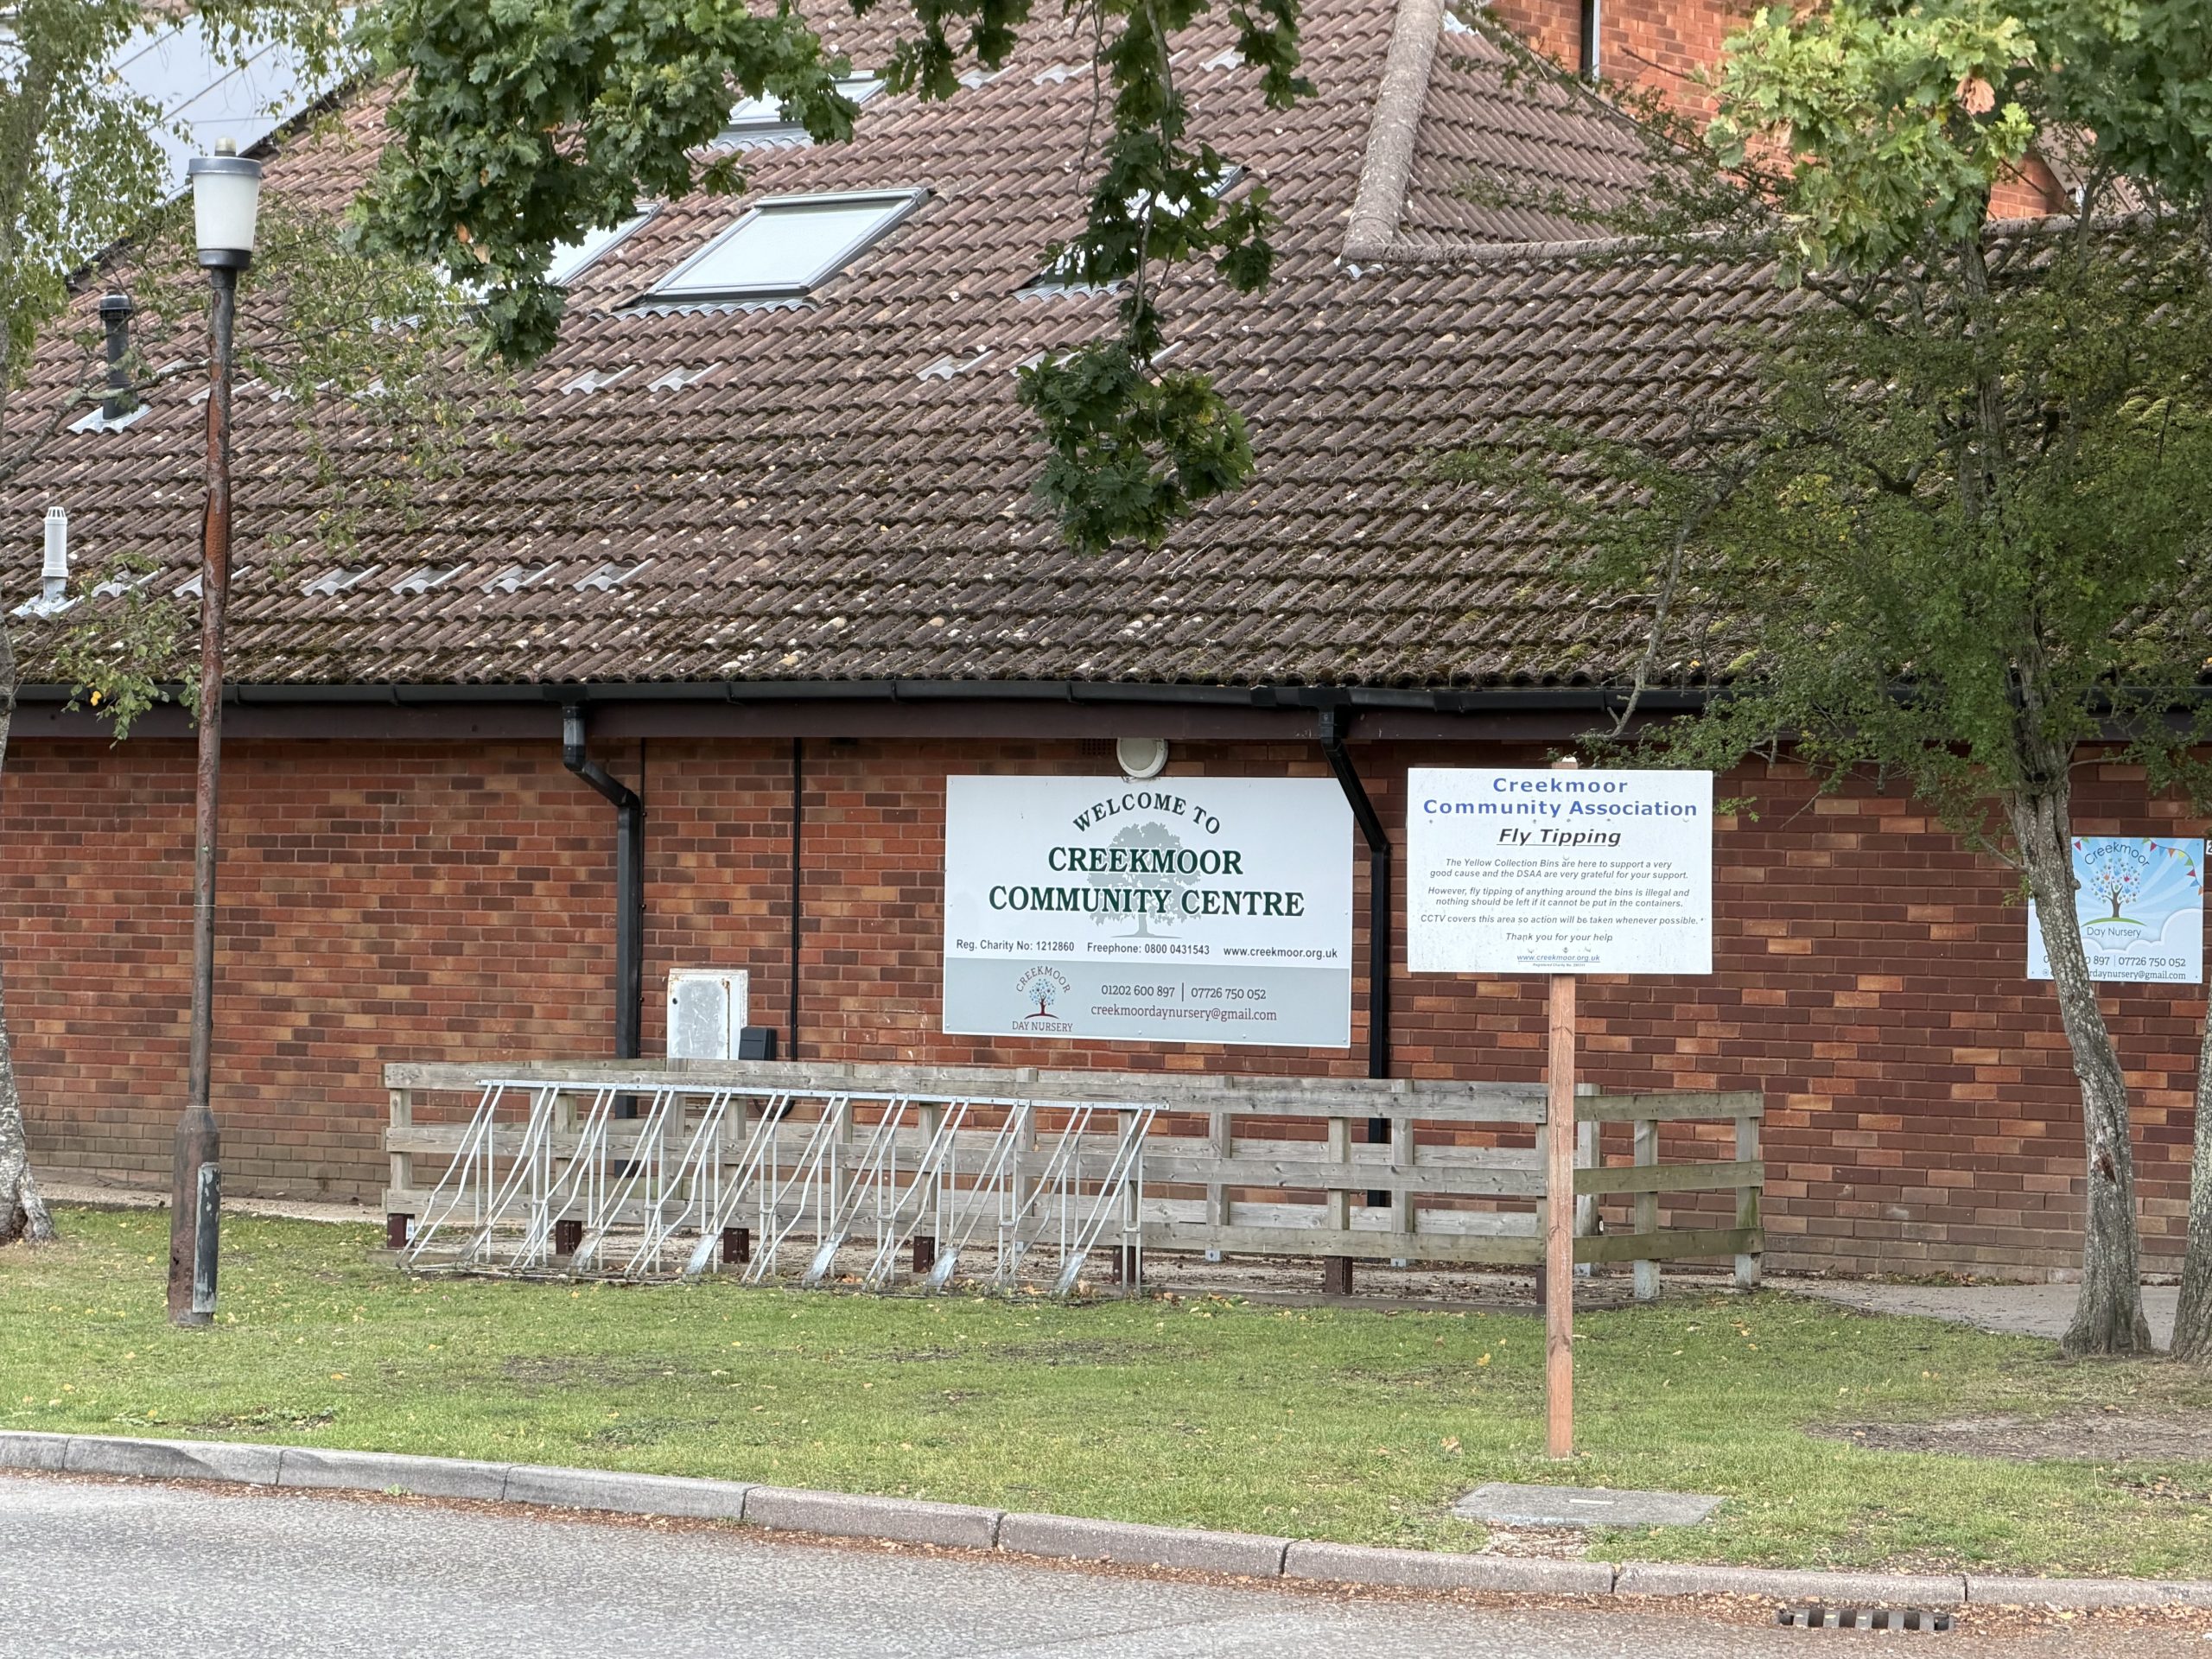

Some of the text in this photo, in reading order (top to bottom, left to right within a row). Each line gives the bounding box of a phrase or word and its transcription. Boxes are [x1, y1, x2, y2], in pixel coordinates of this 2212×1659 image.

[1493, 778, 1628, 793] Creekmoor
[1073, 791, 1221, 835] WELCOME TO
[1424, 799, 1696, 817] Community Association
[1498, 828, 1622, 848] Fly Tipping
[1048, 846, 1243, 875] CREEKMOOR
[2084, 842, 2150, 867] Creekmoor
[1430, 869, 1452, 878] good
[1581, 870, 1614, 880] grateful
[1652, 872, 1688, 881] support.
[1428, 887, 1466, 896] However,
[1470, 887, 1480, 896] fly
[1484, 887, 1514, 897] tipping
[1526, 887, 1563, 897] anything
[1645, 888, 1671, 898] illegal
[988, 885, 1306, 918] COMMUNITY CENTRE
[1436, 897, 1469, 907] nothing
[1592, 899, 1606, 908] put
[1659, 917, 1698, 925] possible.
[1506, 933, 1533, 942] Thank
[1593, 933, 1612, 943] help
[2087, 927, 2142, 938] Day Nursery
[957, 939, 1338, 960] Reg. Charity No: 1212860 Freephone: 0800 0431543 www.creekmoor.org.uk
[1517, 952, 1599, 961] www.creekmoor.org.uk
[2094, 956, 2110, 965] 897
[2119, 957, 2146, 966] 07726
[2149, 957, 2166, 967] 750
[2169, 958, 2186, 968] 052
[1015, 965, 1071, 993] CREEKMOOR
[2088, 969, 2186, 980] rdaynursery@gmail.com
[1102, 985, 1266, 1001] 01202 600 897 07726 750 052
[1091, 1003, 1276, 1022] creekmoordaynursery@gmail.com
[1013, 1021, 1073, 1032] DAY NURSERY
